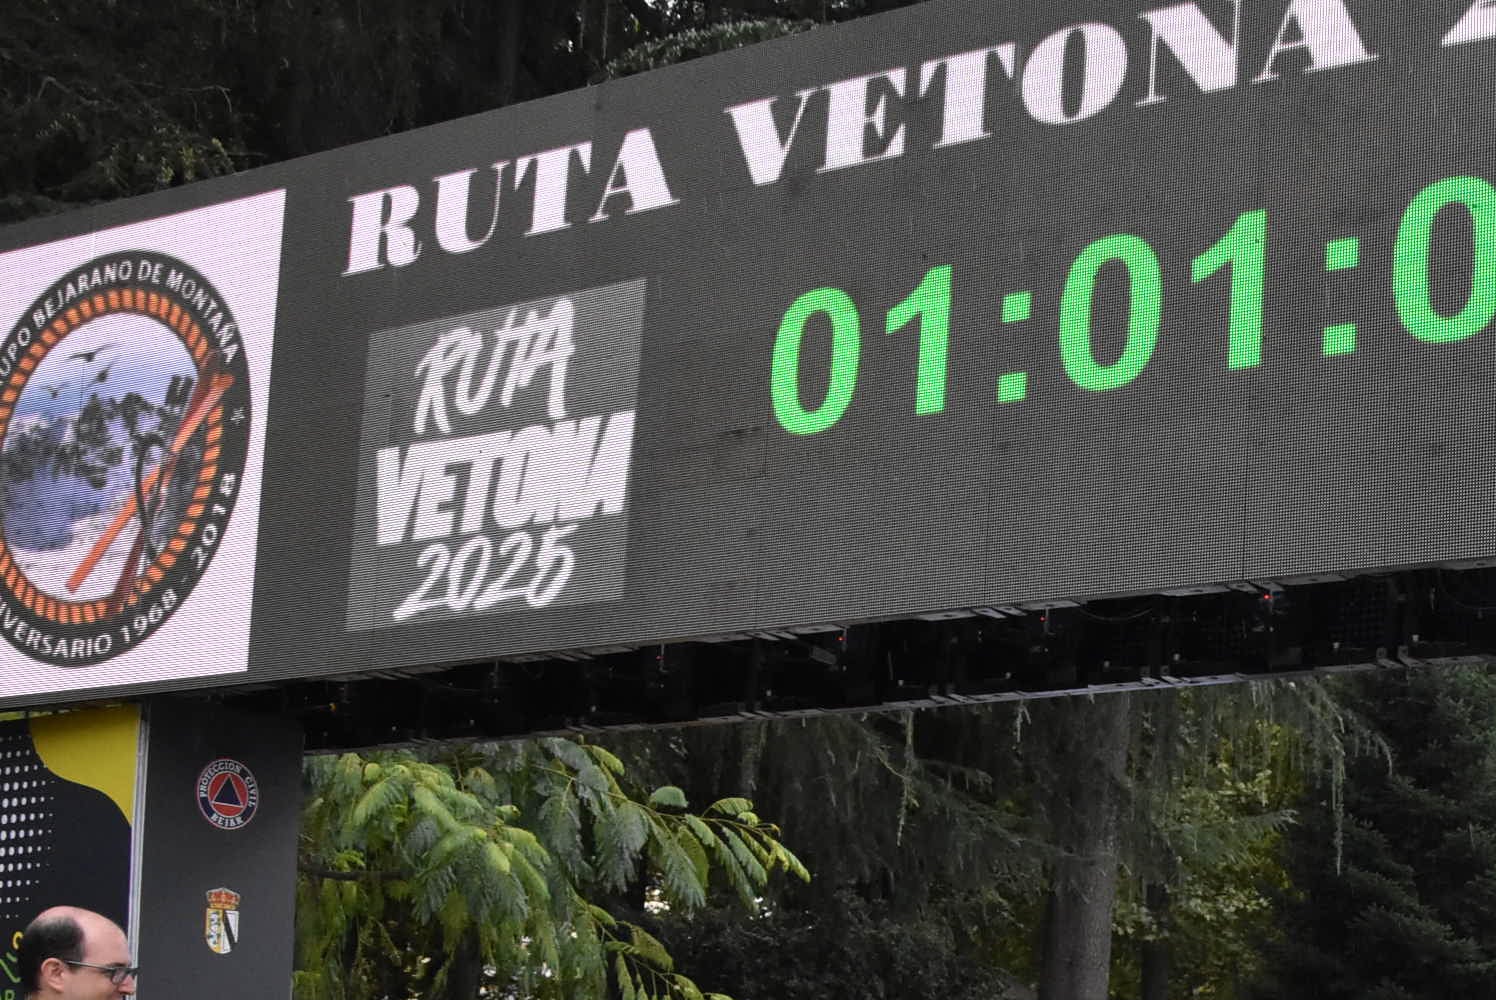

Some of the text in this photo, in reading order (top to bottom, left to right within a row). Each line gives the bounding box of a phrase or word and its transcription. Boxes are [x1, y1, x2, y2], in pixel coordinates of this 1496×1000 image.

[341, 0, 1378, 276] RUTA VETONA
[33, 260, 133, 328] BEJARANO
[138, 260, 164, 284] DE
[166, 268, 240, 364] MONTAÑA
[414, 297, 577, 435] RUTA
[376, 410, 636, 545] VETONA
[120, 588, 178, 643] 1968
[190, 473, 236, 571] 2018
[394, 523, 578, 621] 2025
